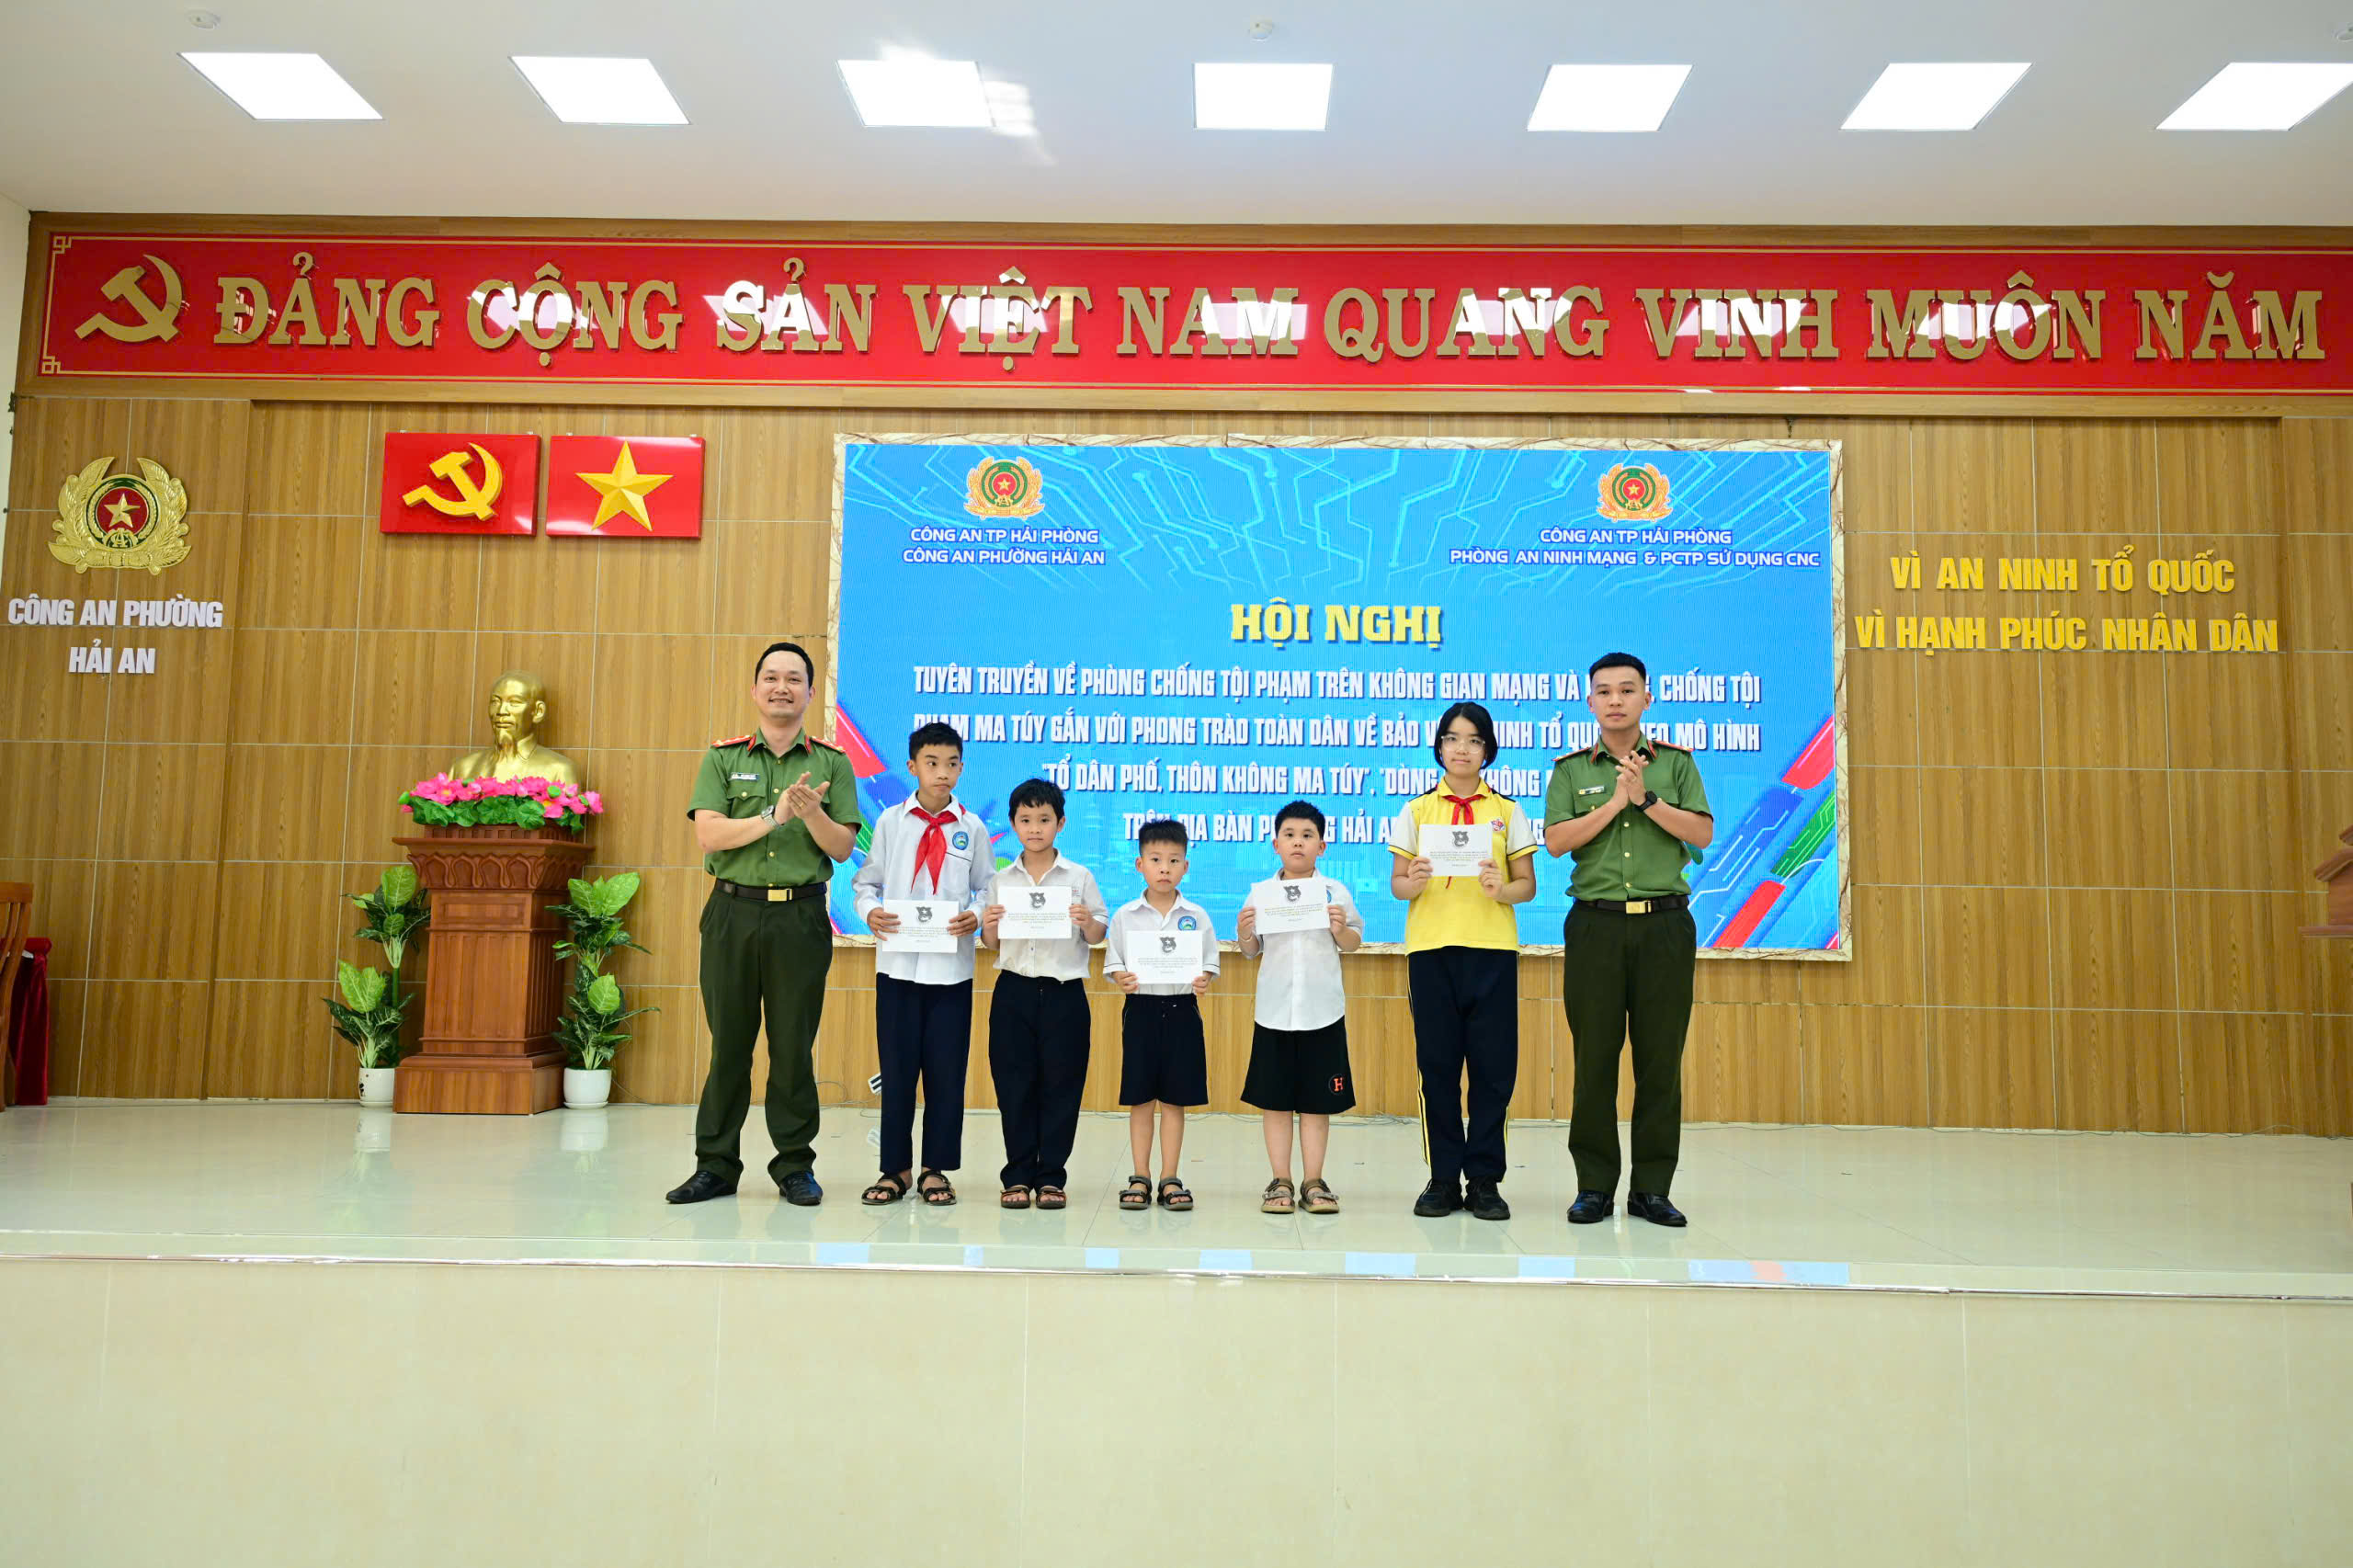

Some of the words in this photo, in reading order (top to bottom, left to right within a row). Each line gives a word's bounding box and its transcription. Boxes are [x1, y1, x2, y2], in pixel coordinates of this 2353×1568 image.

[214, 252, 440, 347] ĐẢNG
[467, 261, 683, 366] CỘNG
[716, 257, 877, 353] SẢN
[903, 266, 1094, 370] VIỆT
[1117, 287, 1299, 357] NAM
[1324, 286, 1611, 362] QUANG
[1635, 289, 1838, 359] VINH
[1866, 270, 2107, 360] MUÔN
[2134, 271, 2325, 359] NĂM
[912, 527, 955, 541] CÔNG
[960, 529, 982, 541] AN
[986, 529, 1006, 541] TP
[1012, 527, 1037, 541] HẢI
[1042, 528, 1097, 542] PHÒNG
[1541, 528, 1586, 542] CÔNG
[1590, 530, 1612, 542] AN
[1617, 531, 1637, 542] TP
[1643, 528, 1668, 542] HẢI
[1674, 528, 1731, 543] PHÒNG
[904, 547, 949, 562] CÔNG
[952, 551, 974, 562] AN
[980, 547, 1048, 563] PHƯỜNG
[1051, 548, 1078, 564] HẢI
[1082, 551, 1105, 564] AN
[1450, 548, 1508, 563] PHÒNG
[1516, 551, 1538, 562] AN
[1544, 551, 1582, 562] NINH
[1587, 551, 1636, 568] MẠNG
[1645, 552, 1656, 564] &
[1662, 552, 1703, 564] PCTP
[1707, 549, 1732, 565] SỬ
[1735, 552, 1783, 569] DỤNG
[1787, 553, 1818, 565] CNC
[1891, 550, 1921, 589] VÌ
[1937, 557, 1984, 590] AN
[1998, 558, 2078, 591] NINH
[2091, 545, 2134, 591] TỔ
[2148, 549, 2234, 595] QUỐC
[8, 593, 74, 625] CÔNG
[80, 600, 117, 625] AN
[122, 593, 223, 628] PHƯỜNG
[1231, 597, 1310, 647] HỘI
[1325, 605, 1441, 648] NGHỊ
[1855, 608, 1885, 647] VÌ
[1896, 617, 1986, 656] HẠNH
[2000, 610, 2087, 650] PHÚC
[2103, 612, 2198, 651] NHÂN
[2208, 612, 2279, 652] DÂN
[69, 638, 112, 674] HẢI
[118, 648, 155, 673] AN
[915, 663, 972, 692] TUYÊN
[978, 662, 1047, 693] TRUYỀN
[1054, 662, 1075, 694] VỀ
[1082, 665, 1144, 695] PHÒNG
[1152, 662, 1214, 695] CHỐNG
[1221, 666, 1248, 702] TỘI
[1256, 671, 1310, 702] PHẠM
[1316, 667, 1362, 697] TRÊN
[1370, 668, 1433, 698] KHÔNG
[1440, 673, 1484, 699] GIAN
[1492, 674, 1549, 705] MẠNG
[1555, 670, 1579, 699] VÀ
[1660, 667, 1724, 701] CHỐNG
[1731, 672, 1759, 708] TỘI
[975, 715, 1005, 741] MA
[1012, 711, 1045, 741] TÚY
[1051, 707, 1088, 742] GẮN
[1096, 712, 1125, 742] VỚI
[1132, 717, 1195, 743] PHONG
[1201, 713, 1247, 744] TRÀO
[1255, 714, 1302, 744] TOÀN
[1310, 715, 1347, 744] DÂN
[1354, 713, 1376, 745] VỀ
[1382, 712, 1418, 745] BẢO
[1425, 716, 1440, 747] V
[1493, 720, 1533, 747] INH
[1539, 711, 1562, 747] TỔ
[1567, 720, 1601, 750] QU
[1675, 719, 1706, 749] MÔ
[1713, 720, 1759, 750] HÌNH
[1075, 760, 1114, 790] DÂN
[1120, 757, 1162, 791] PHỐ,
[1166, 761, 1216, 791] THÔN
[1223, 762, 1287, 792] KHÔNG
[1294, 767, 1324, 792] MA
[1213, 811, 1252, 841] BÀN
[1342, 809, 1371, 842] HẢI
[1378, 815, 1396, 844] A
